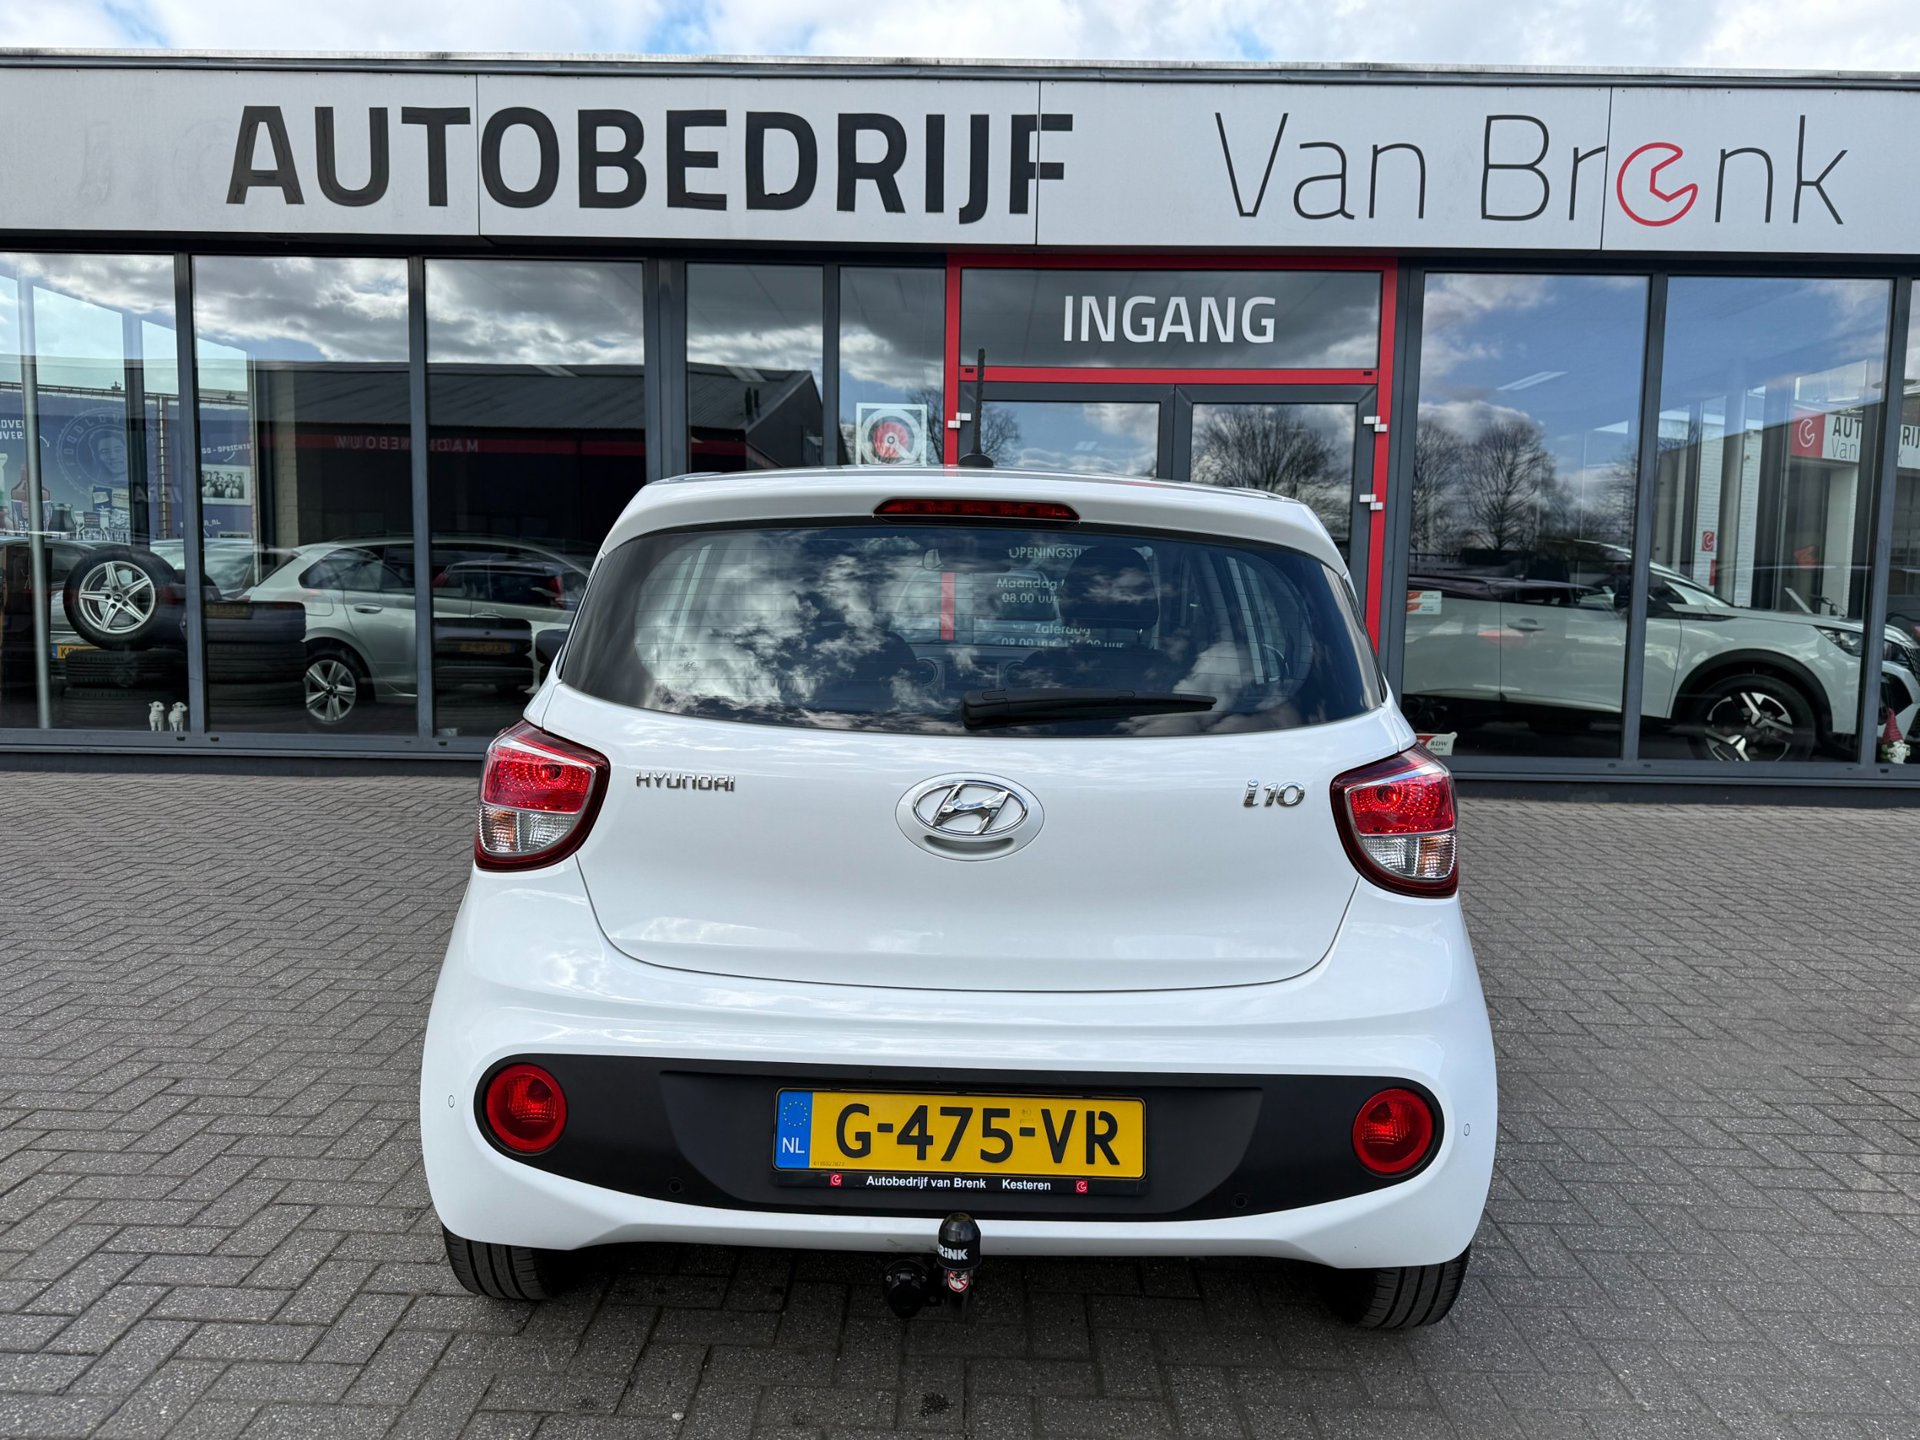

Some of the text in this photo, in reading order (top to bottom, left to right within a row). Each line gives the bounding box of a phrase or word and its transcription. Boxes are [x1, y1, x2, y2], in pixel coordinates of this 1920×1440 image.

[226, 105, 1074, 225] AUTOBEDRIJF
[1214, 111, 1426, 220] Van
[1063, 294, 1277, 344] INGANG
[996, 578, 1058, 591] Maandag
[1002, 592, 1035, 604] 08.00
[636, 769, 736, 793] HYUNDAI
[1243, 779, 1306, 808] i10
[782, 1102, 1121, 1166] NL G-475-VR
[866, 1174, 1052, 1191] Autobedrijf van Brenk Kesteren
